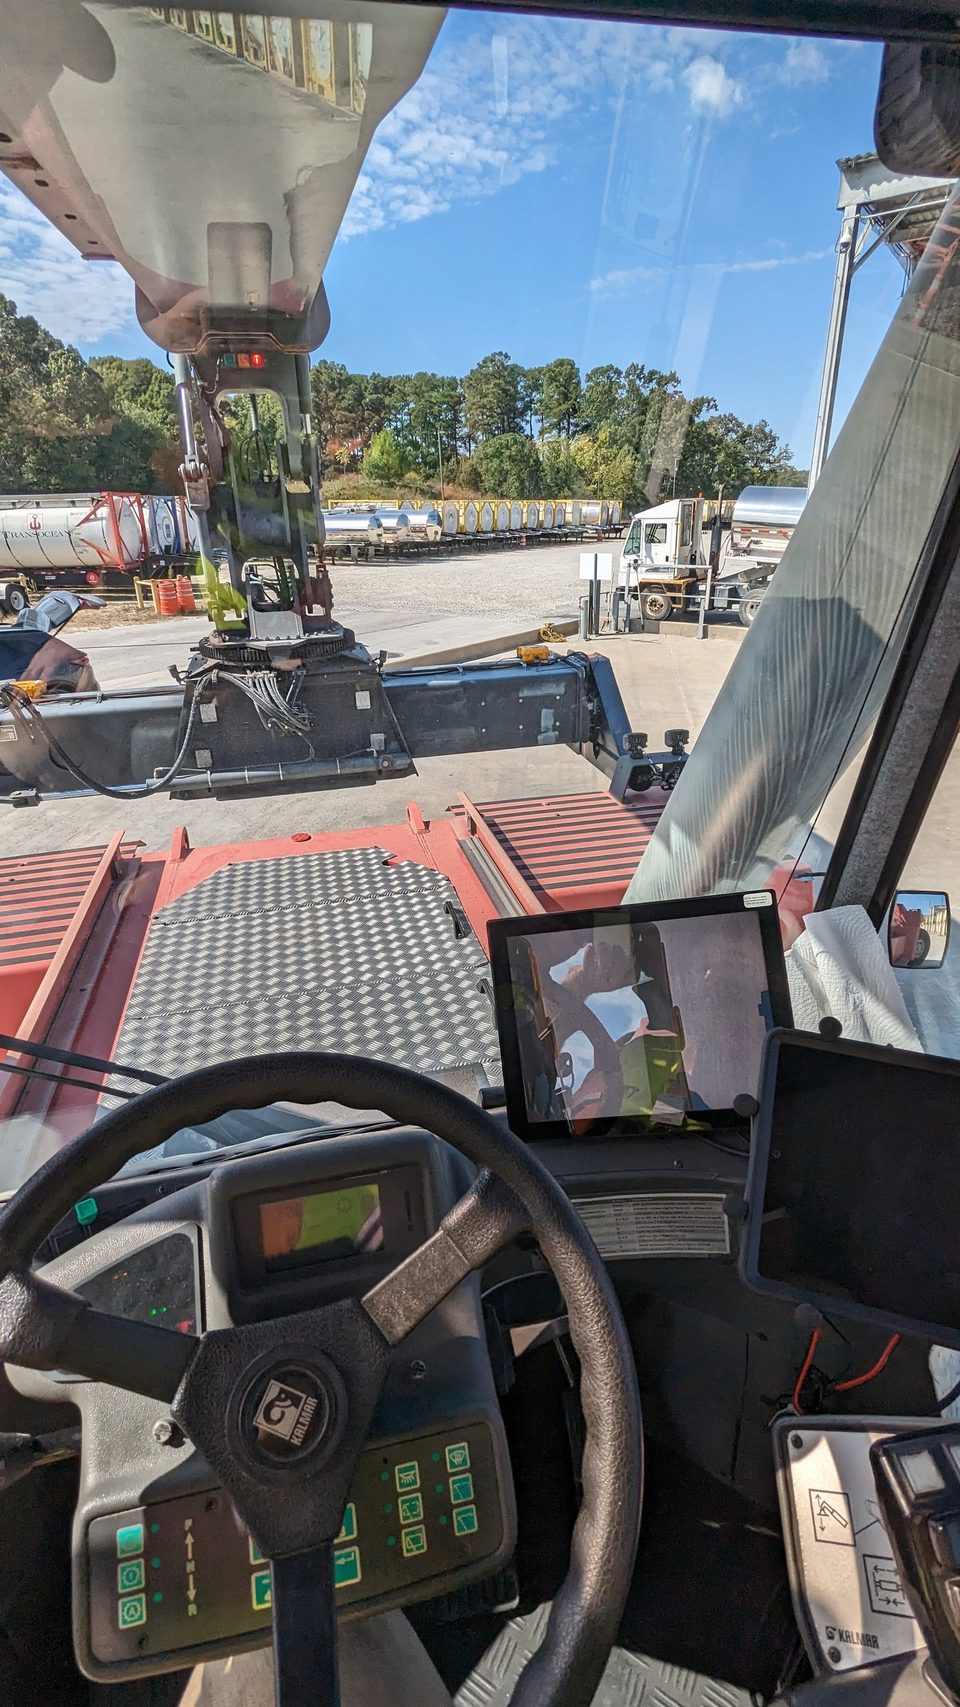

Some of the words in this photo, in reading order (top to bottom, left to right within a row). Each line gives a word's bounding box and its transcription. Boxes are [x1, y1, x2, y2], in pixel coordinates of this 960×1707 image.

[2, 530, 70, 539] TRANSOCEAN
[290, 1396, 318, 1446] KALMAR
[184, 1518, 193, 1531] F
[186, 1560, 195, 1573] N
[188, 1603, 197, 1617] R
[838, 1628, 879, 1649] KALMAR
